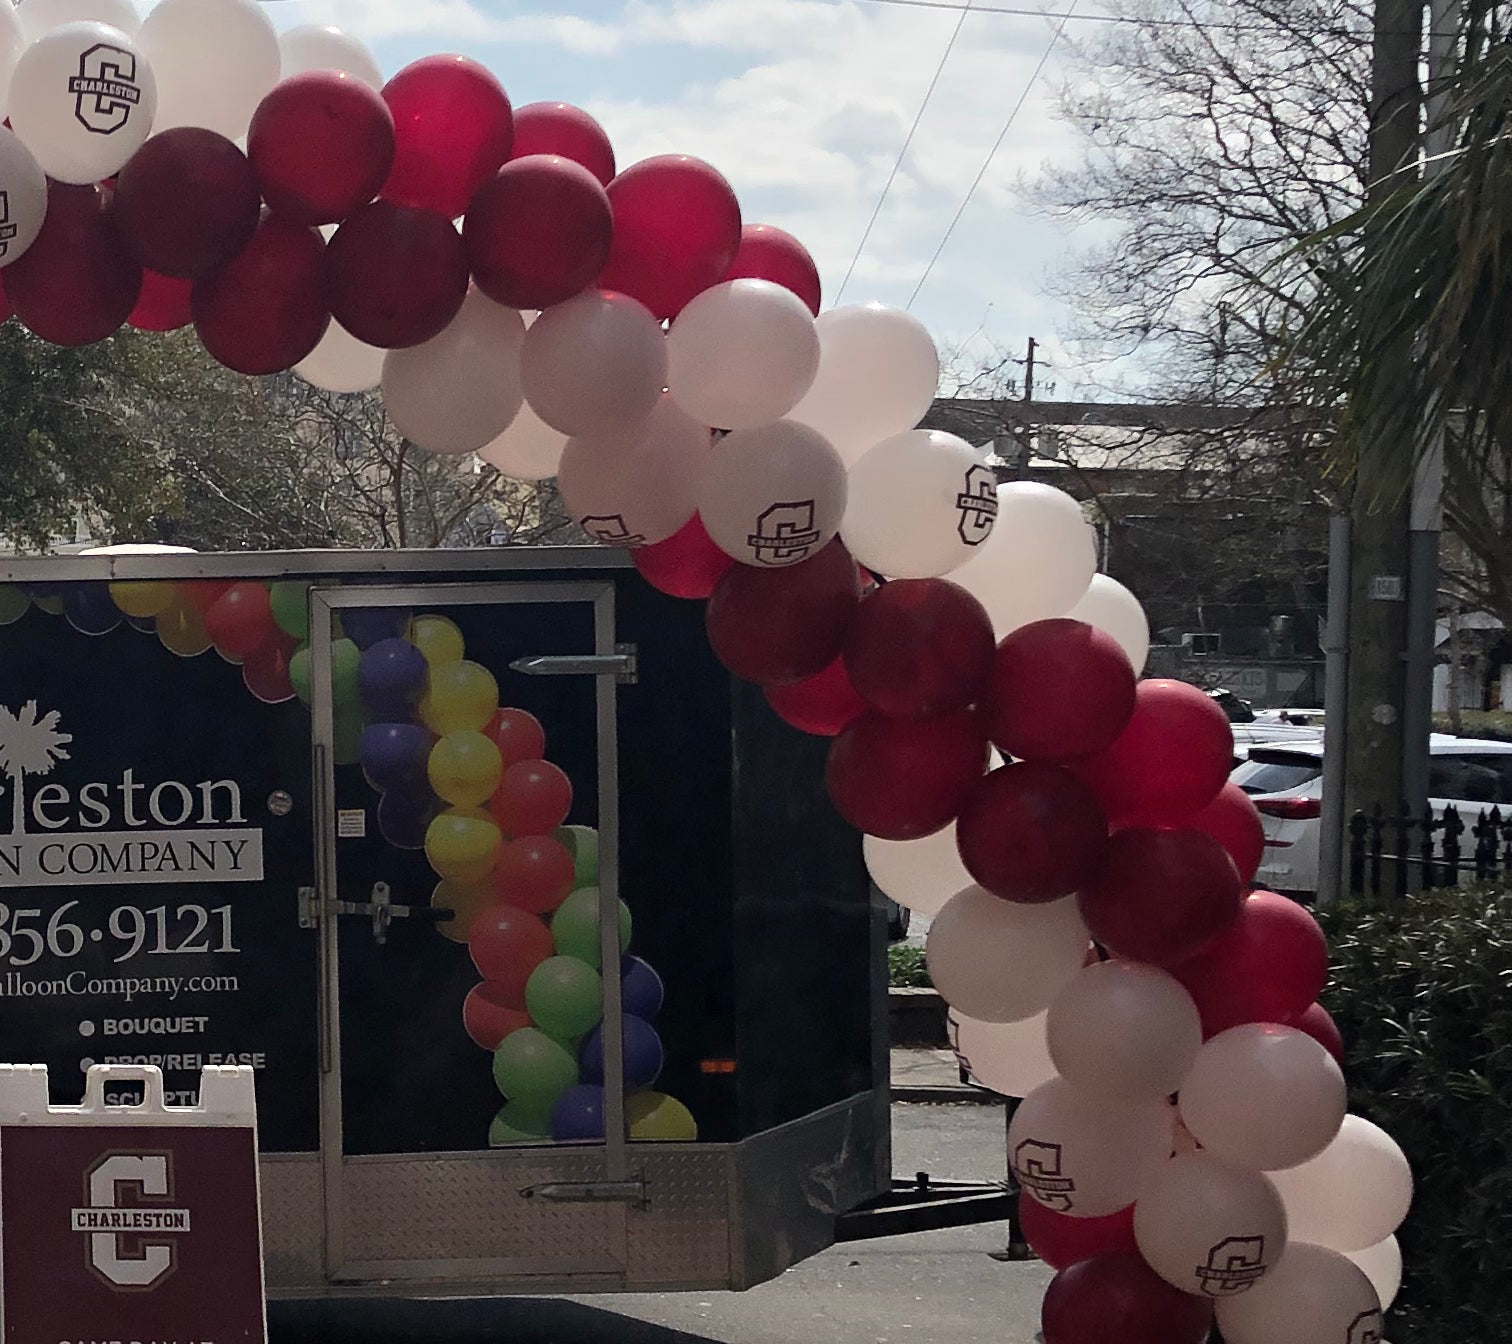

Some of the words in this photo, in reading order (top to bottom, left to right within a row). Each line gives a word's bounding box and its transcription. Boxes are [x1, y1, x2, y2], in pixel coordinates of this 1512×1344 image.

[71, 79, 139, 102] CHARLESTON
[38, 839, 248, 876] COMPANY
[103, 1016, 209, 1036] BOUQUET
[76, 1212, 185, 1228] CHARLESTON
